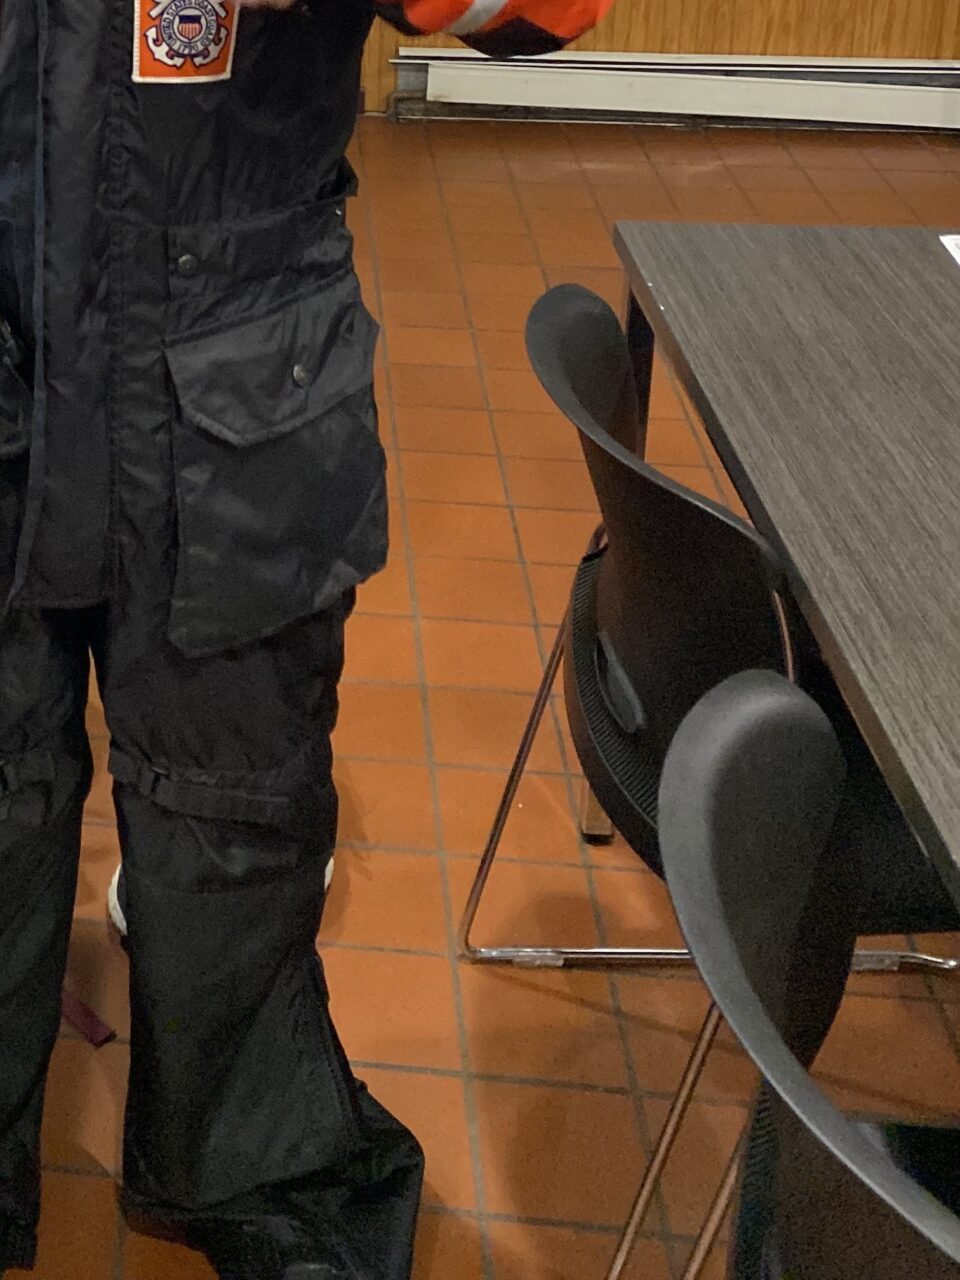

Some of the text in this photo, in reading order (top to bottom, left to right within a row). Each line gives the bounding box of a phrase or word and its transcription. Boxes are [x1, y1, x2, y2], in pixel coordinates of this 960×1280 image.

[163, 17, 177, 47] UNITED
[200, 19, 216, 47] GUARD
[177, 43, 199, 53] 1790
